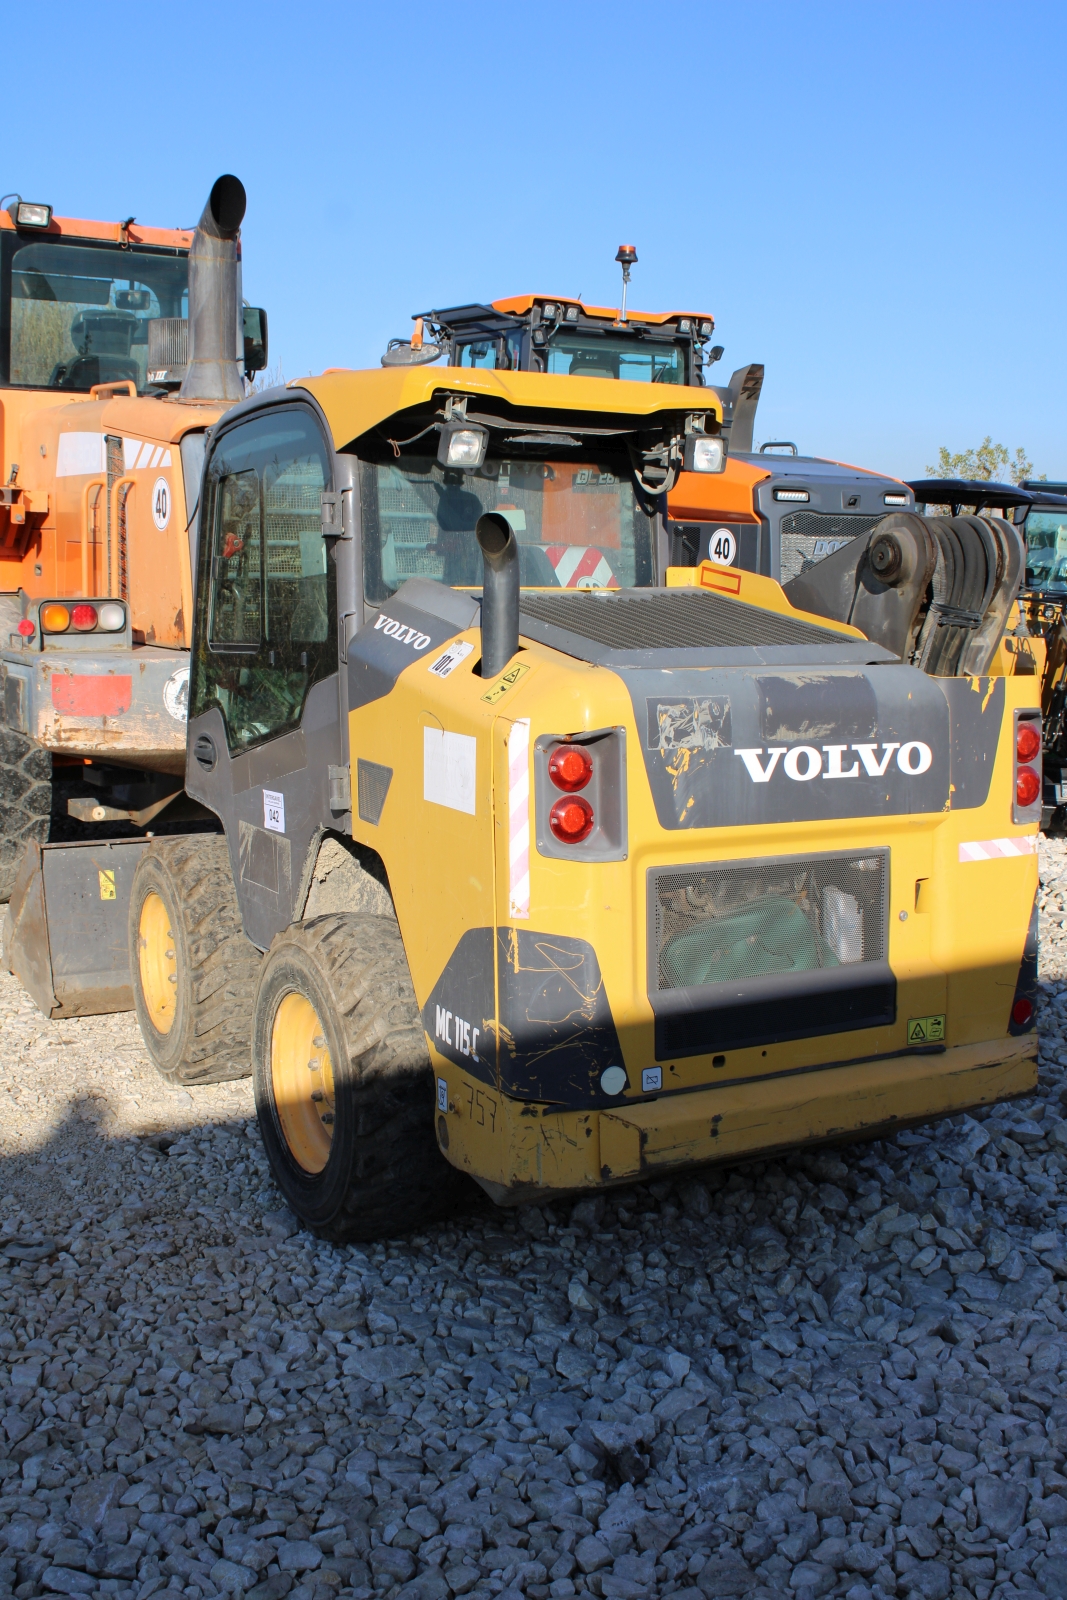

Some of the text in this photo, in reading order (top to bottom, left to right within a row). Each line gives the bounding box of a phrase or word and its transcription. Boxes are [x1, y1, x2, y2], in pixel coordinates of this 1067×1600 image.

[156, 488, 167, 519] 40
[714, 537, 730, 560] 40
[373, 614, 432, 650] VOLVO
[174, 680, 189, 710] 4
[733, 741, 933, 783] VOLVO
[269, 808, 279, 823] 042
[435, 1004, 453, 1046] MC
[455, 1015, 471, 1056] 115
[461, 1080, 497, 1133] 757
